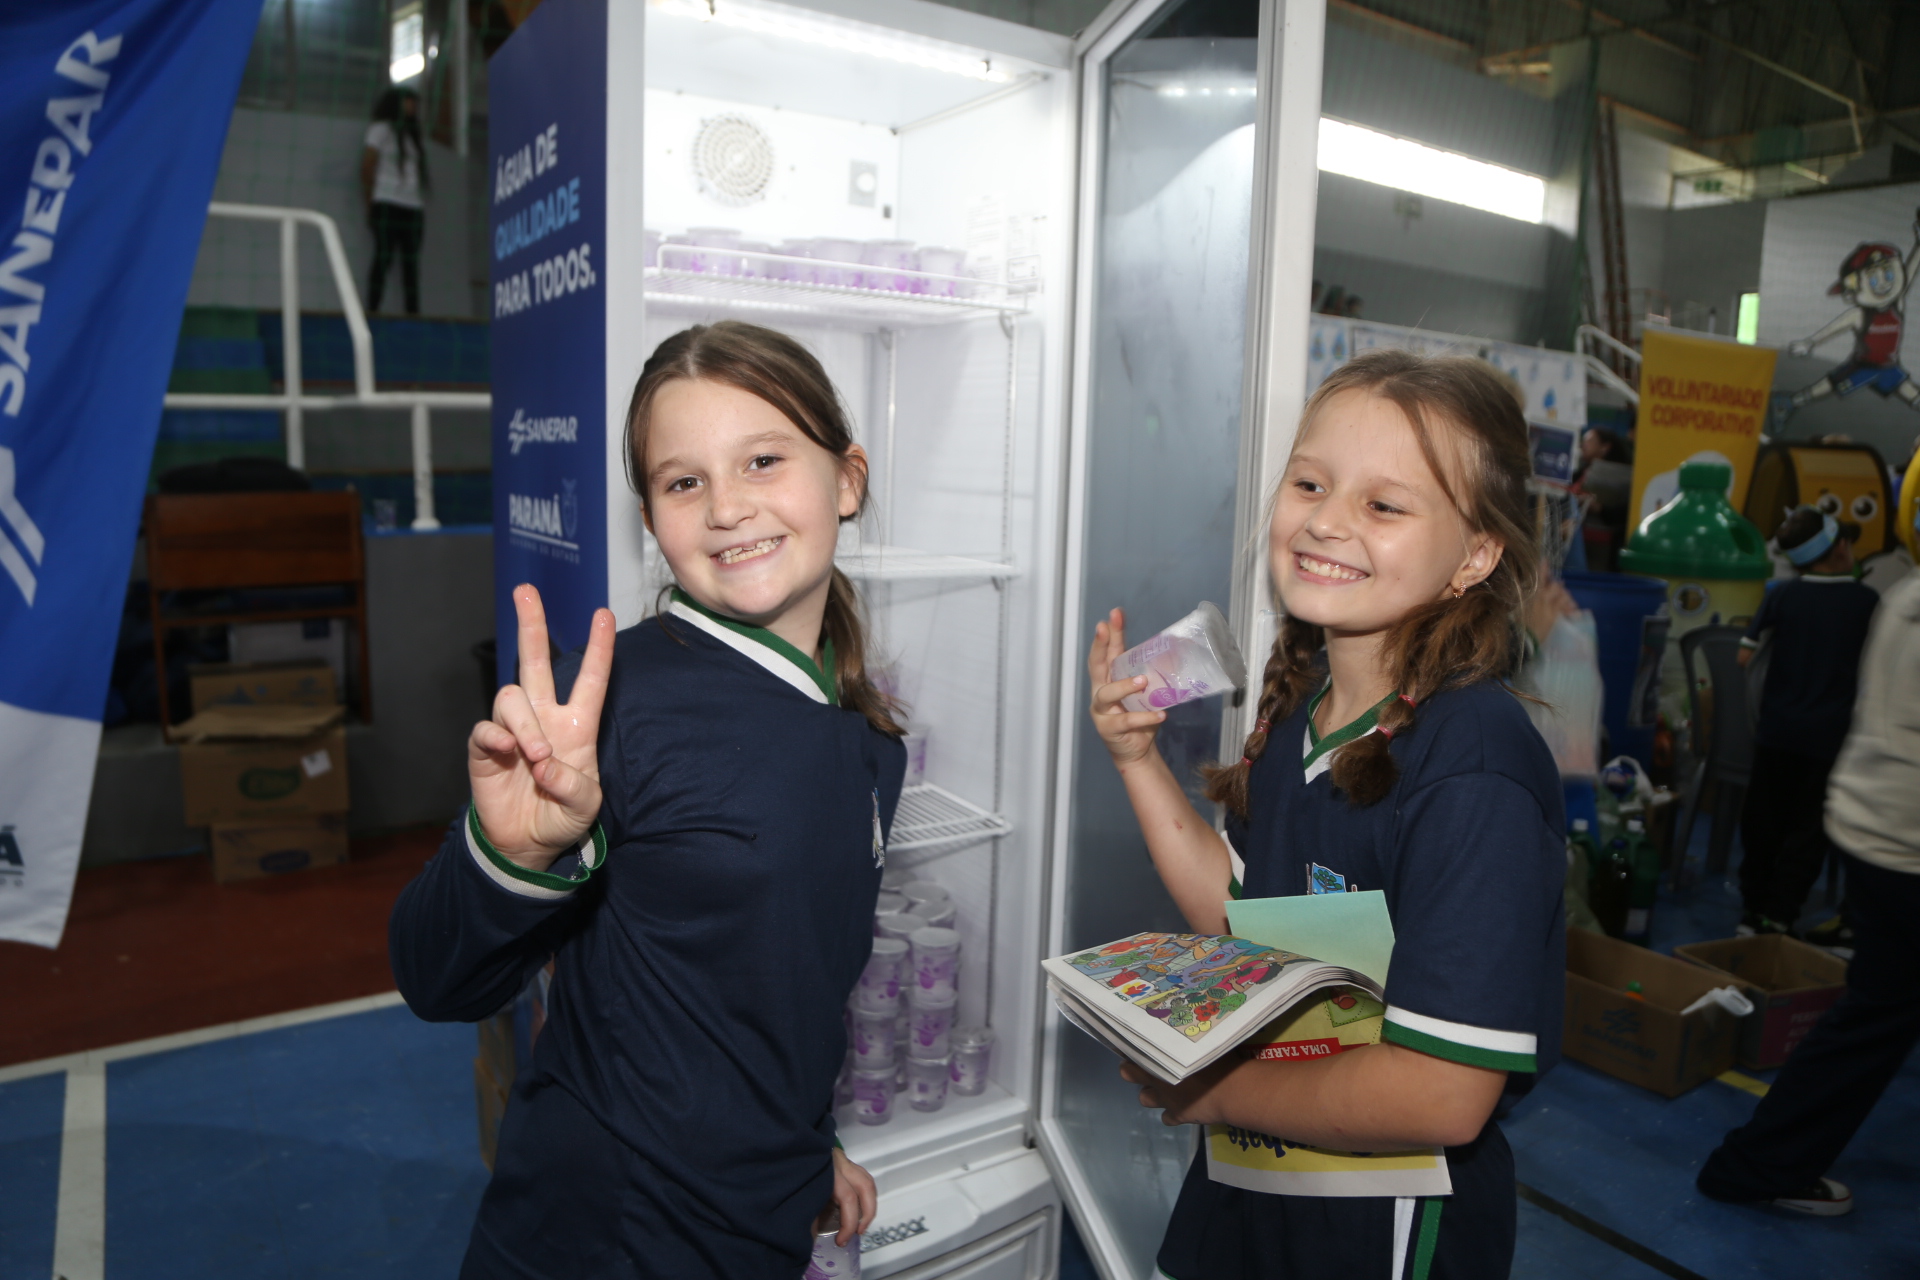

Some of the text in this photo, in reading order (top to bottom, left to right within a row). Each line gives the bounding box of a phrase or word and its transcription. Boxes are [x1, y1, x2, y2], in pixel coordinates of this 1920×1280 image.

[494, 122, 558, 205] ÁGUA DE
[494, 175, 581, 262] QUALIDADE
[494, 242, 597, 319] PARA TODOS.
[525, 415, 579, 443] SANEPAR
[508, 493, 564, 538] PARANÁ
[1300, 1043, 1331, 1056] UMA
